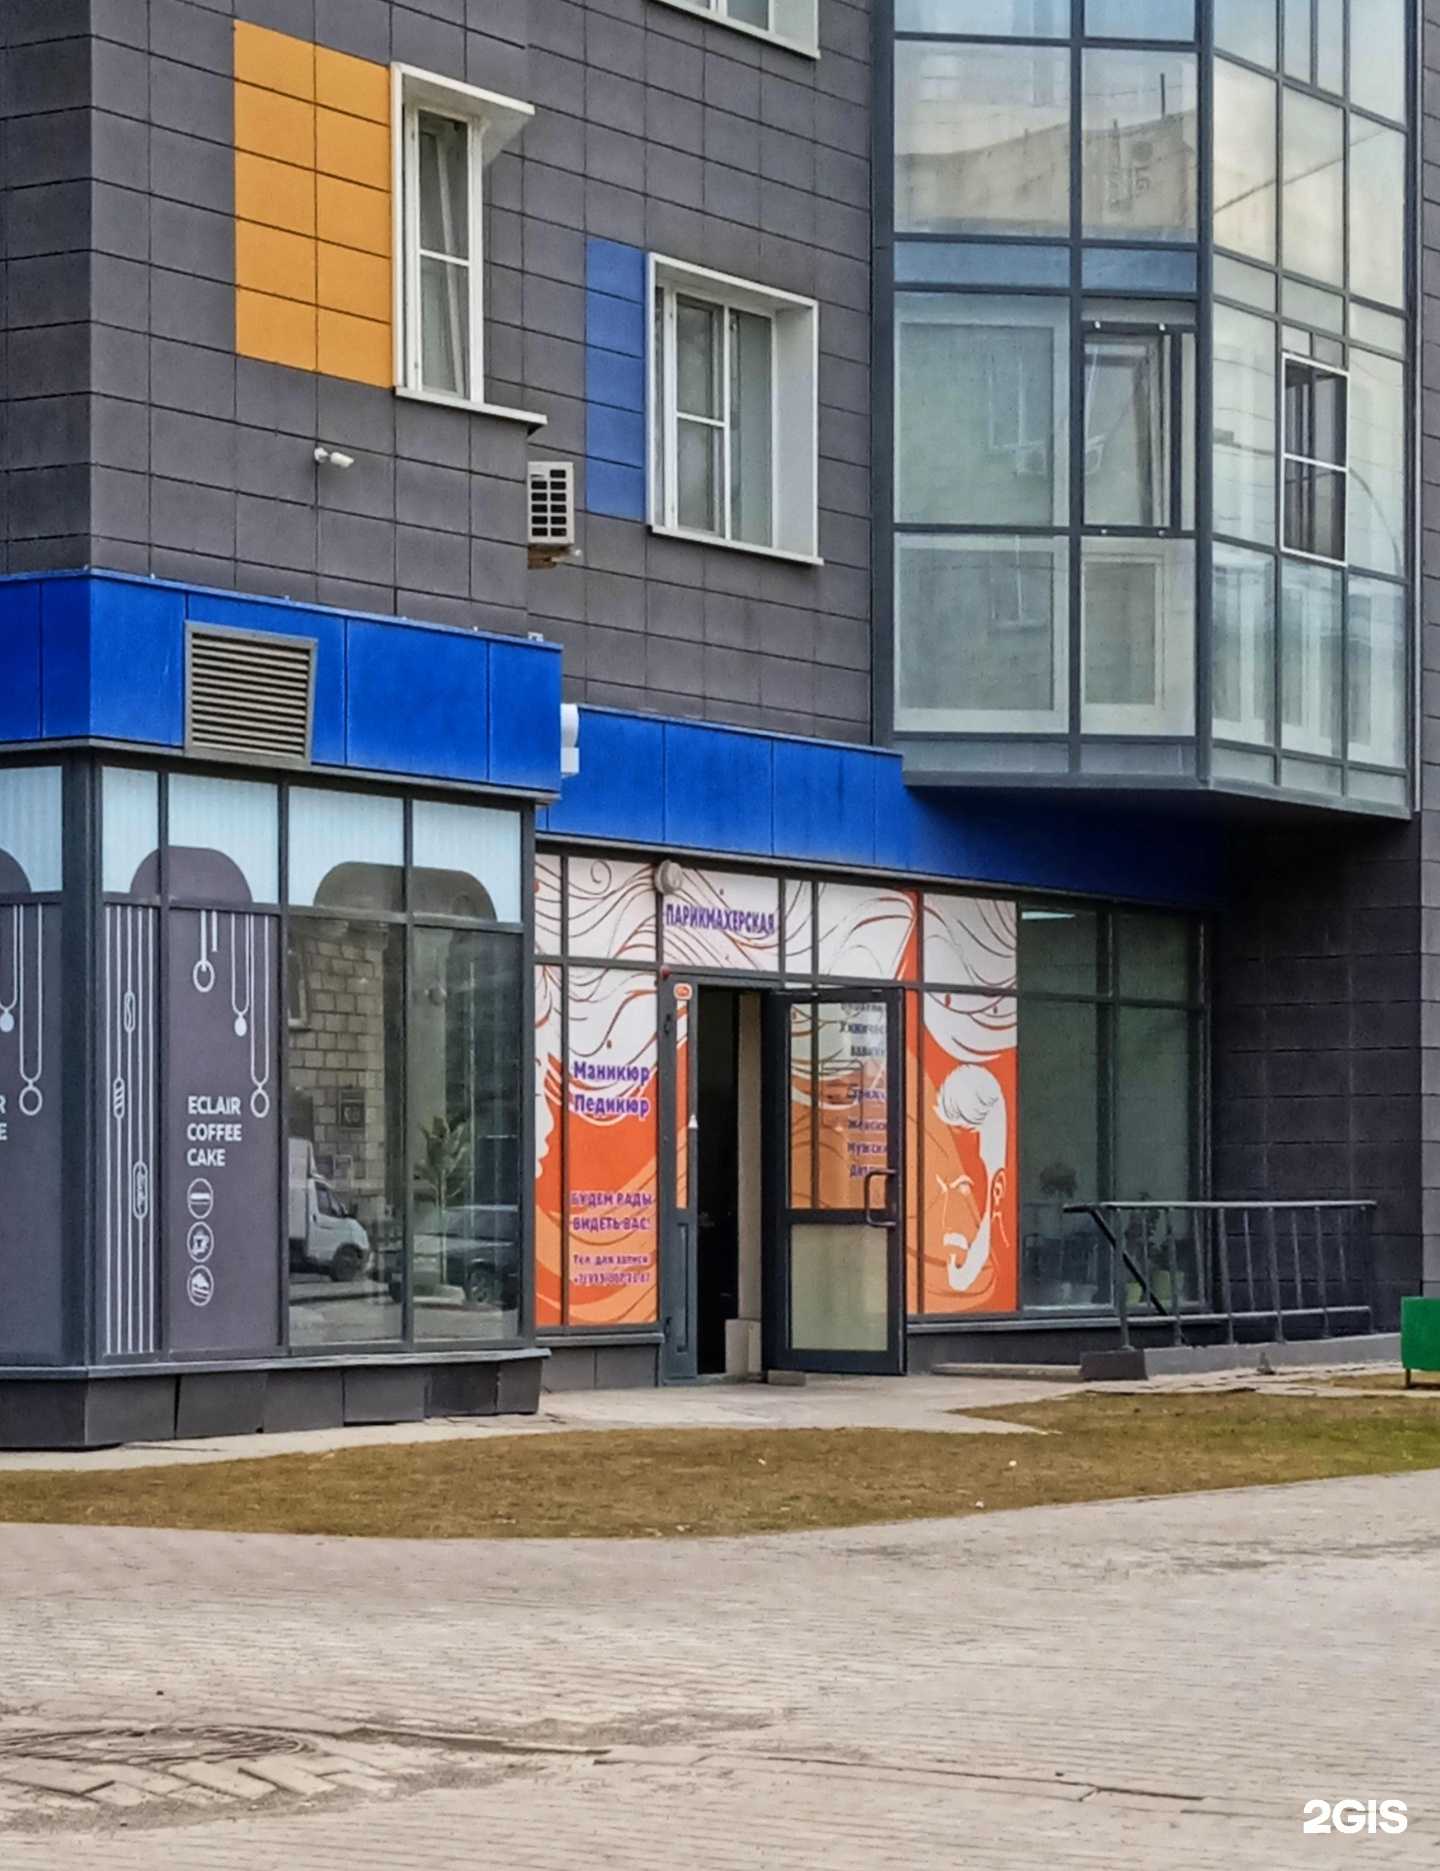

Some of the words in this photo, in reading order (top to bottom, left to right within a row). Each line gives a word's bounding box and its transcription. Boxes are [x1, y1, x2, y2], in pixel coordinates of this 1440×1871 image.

[666, 904, 775, 934] ПАРИКМАХЕРСКАЯ
[573, 1061, 650, 1085] Маникюр
[187, 1095, 241, 1114] ECLAIR
[574, 1094, 650, 1117] Педикюр
[187, 1123, 242, 1142] COFFEE
[187, 1148, 226, 1167] CAKE
[571, 1193, 613, 1207] БУДЕМ
[616, 1193, 652, 1207] РАДЫ
[573, 1217, 620, 1232] ВИДЕТЬ
